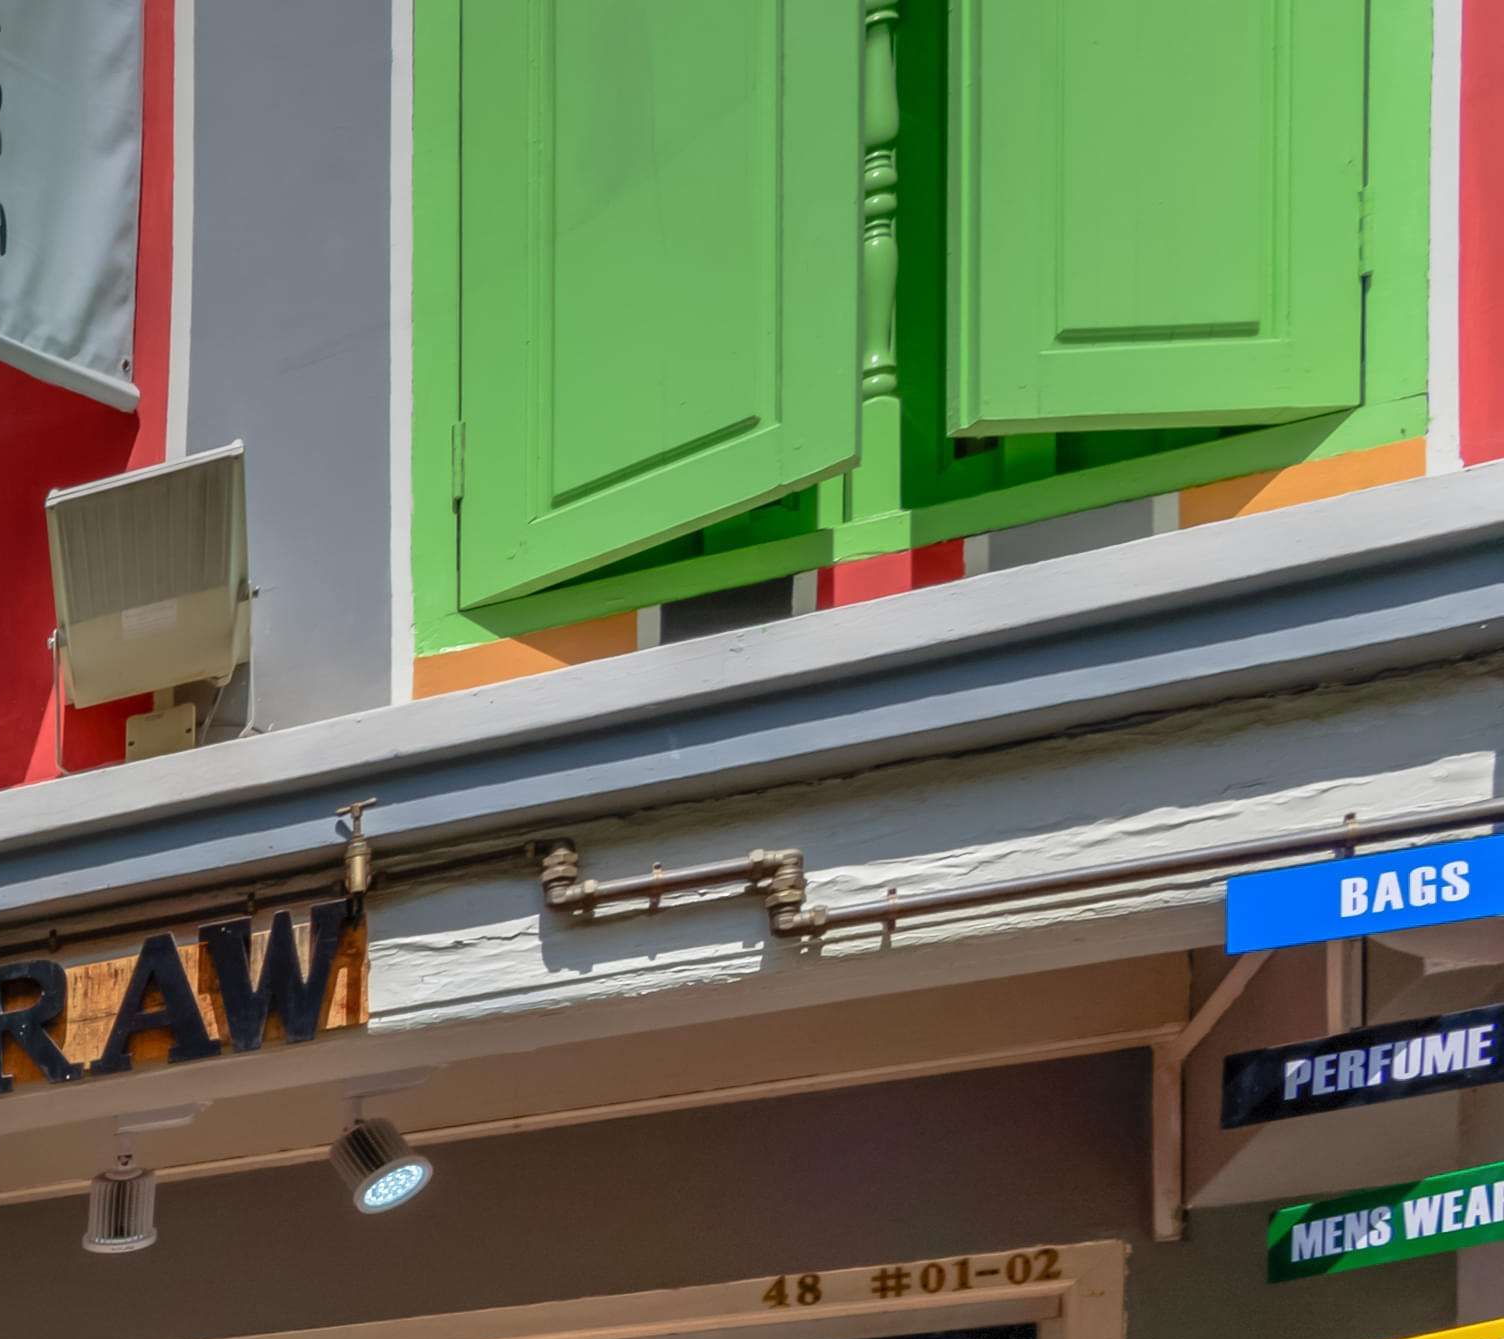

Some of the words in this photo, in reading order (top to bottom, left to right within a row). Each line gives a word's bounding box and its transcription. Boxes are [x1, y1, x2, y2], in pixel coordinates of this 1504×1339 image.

[1340, 860, 1470, 918] BAGS
[1284, 1023, 1495, 1101] PERFUME
[1291, 1205, 1391, 1263] MENS
[761, 1274, 822, 1308] 48
[870, 1248, 1062, 1299] #01-02
